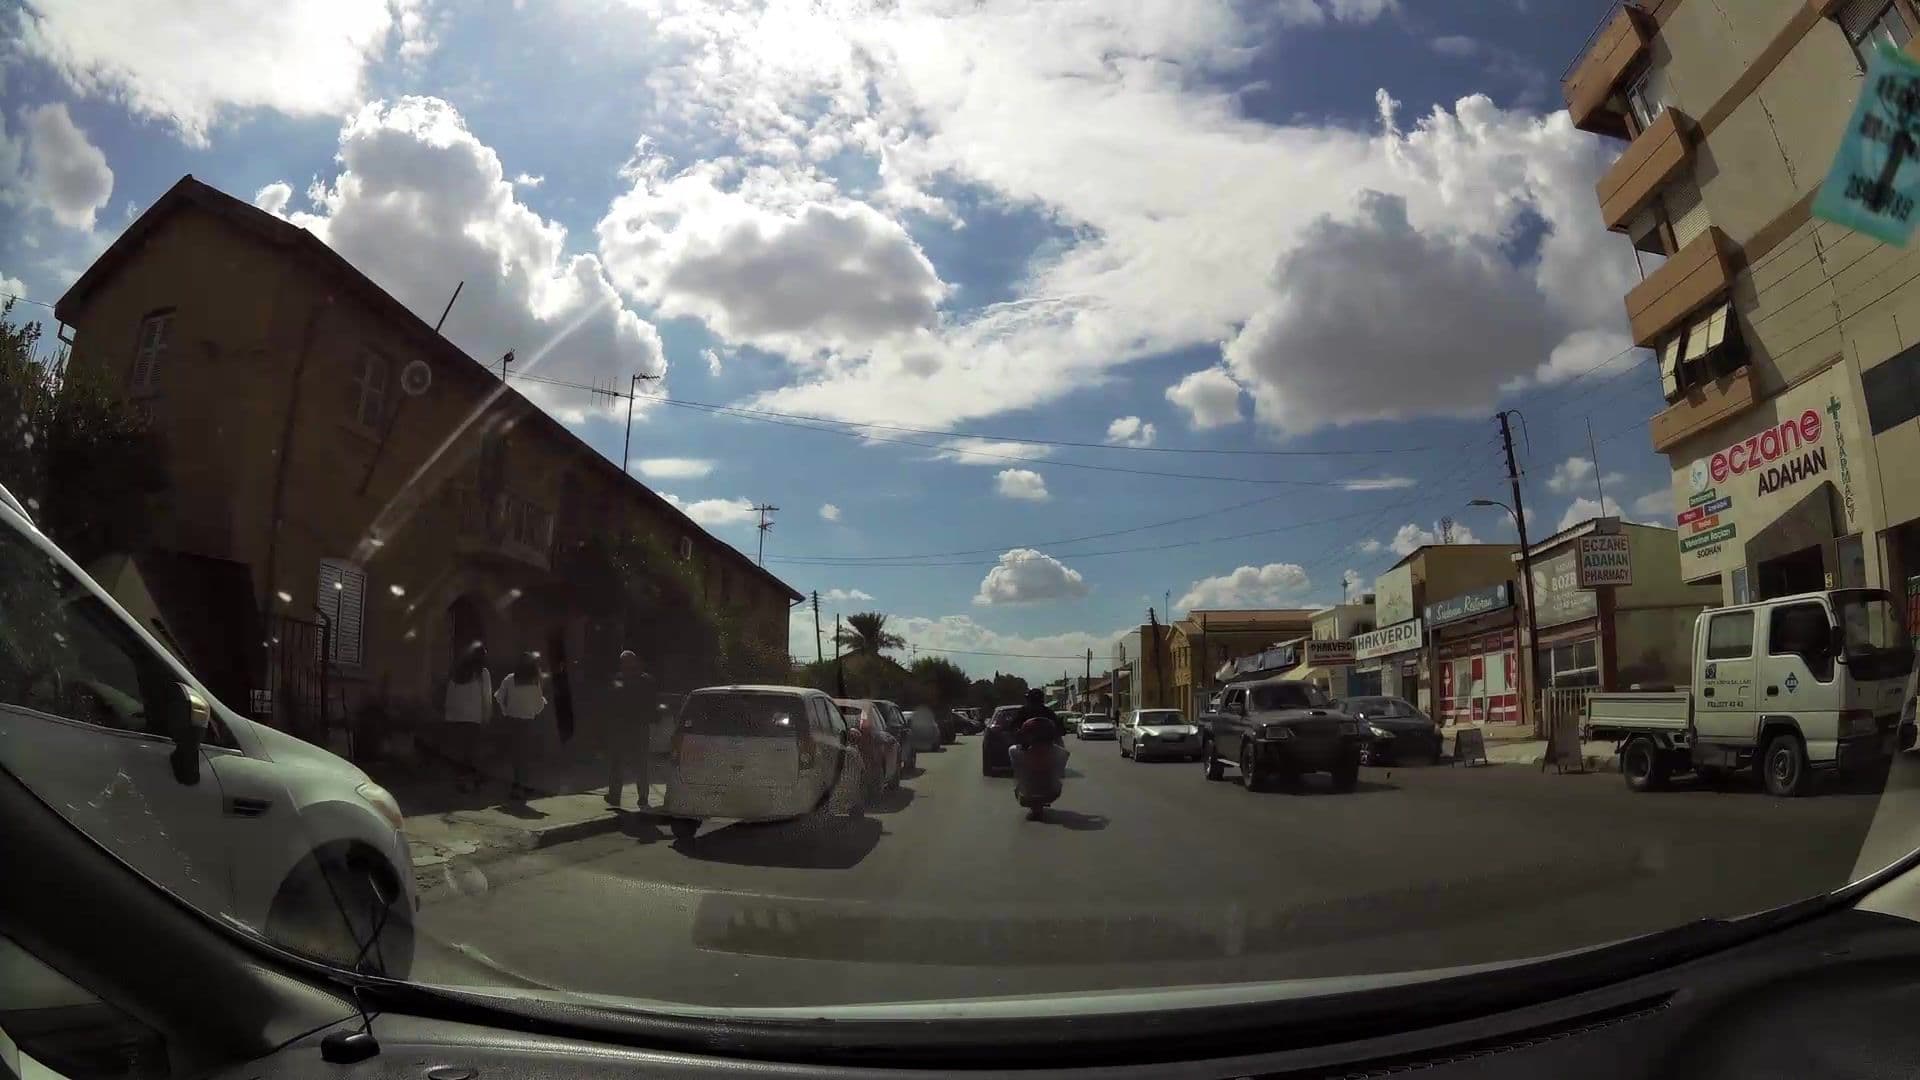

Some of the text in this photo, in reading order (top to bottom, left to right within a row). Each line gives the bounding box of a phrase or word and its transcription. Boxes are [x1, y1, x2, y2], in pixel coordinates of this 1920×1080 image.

[1710, 409, 1822, 484] eczane
[1758, 446, 1828, 497] ADAHAN
[1583, 537, 1627, 552] ECZANE
[1583, 552, 1629, 568] ADAHAN
[1584, 568, 1630, 583] PHARMACY
[1357, 618, 1418, 651] HAKVERDİ
